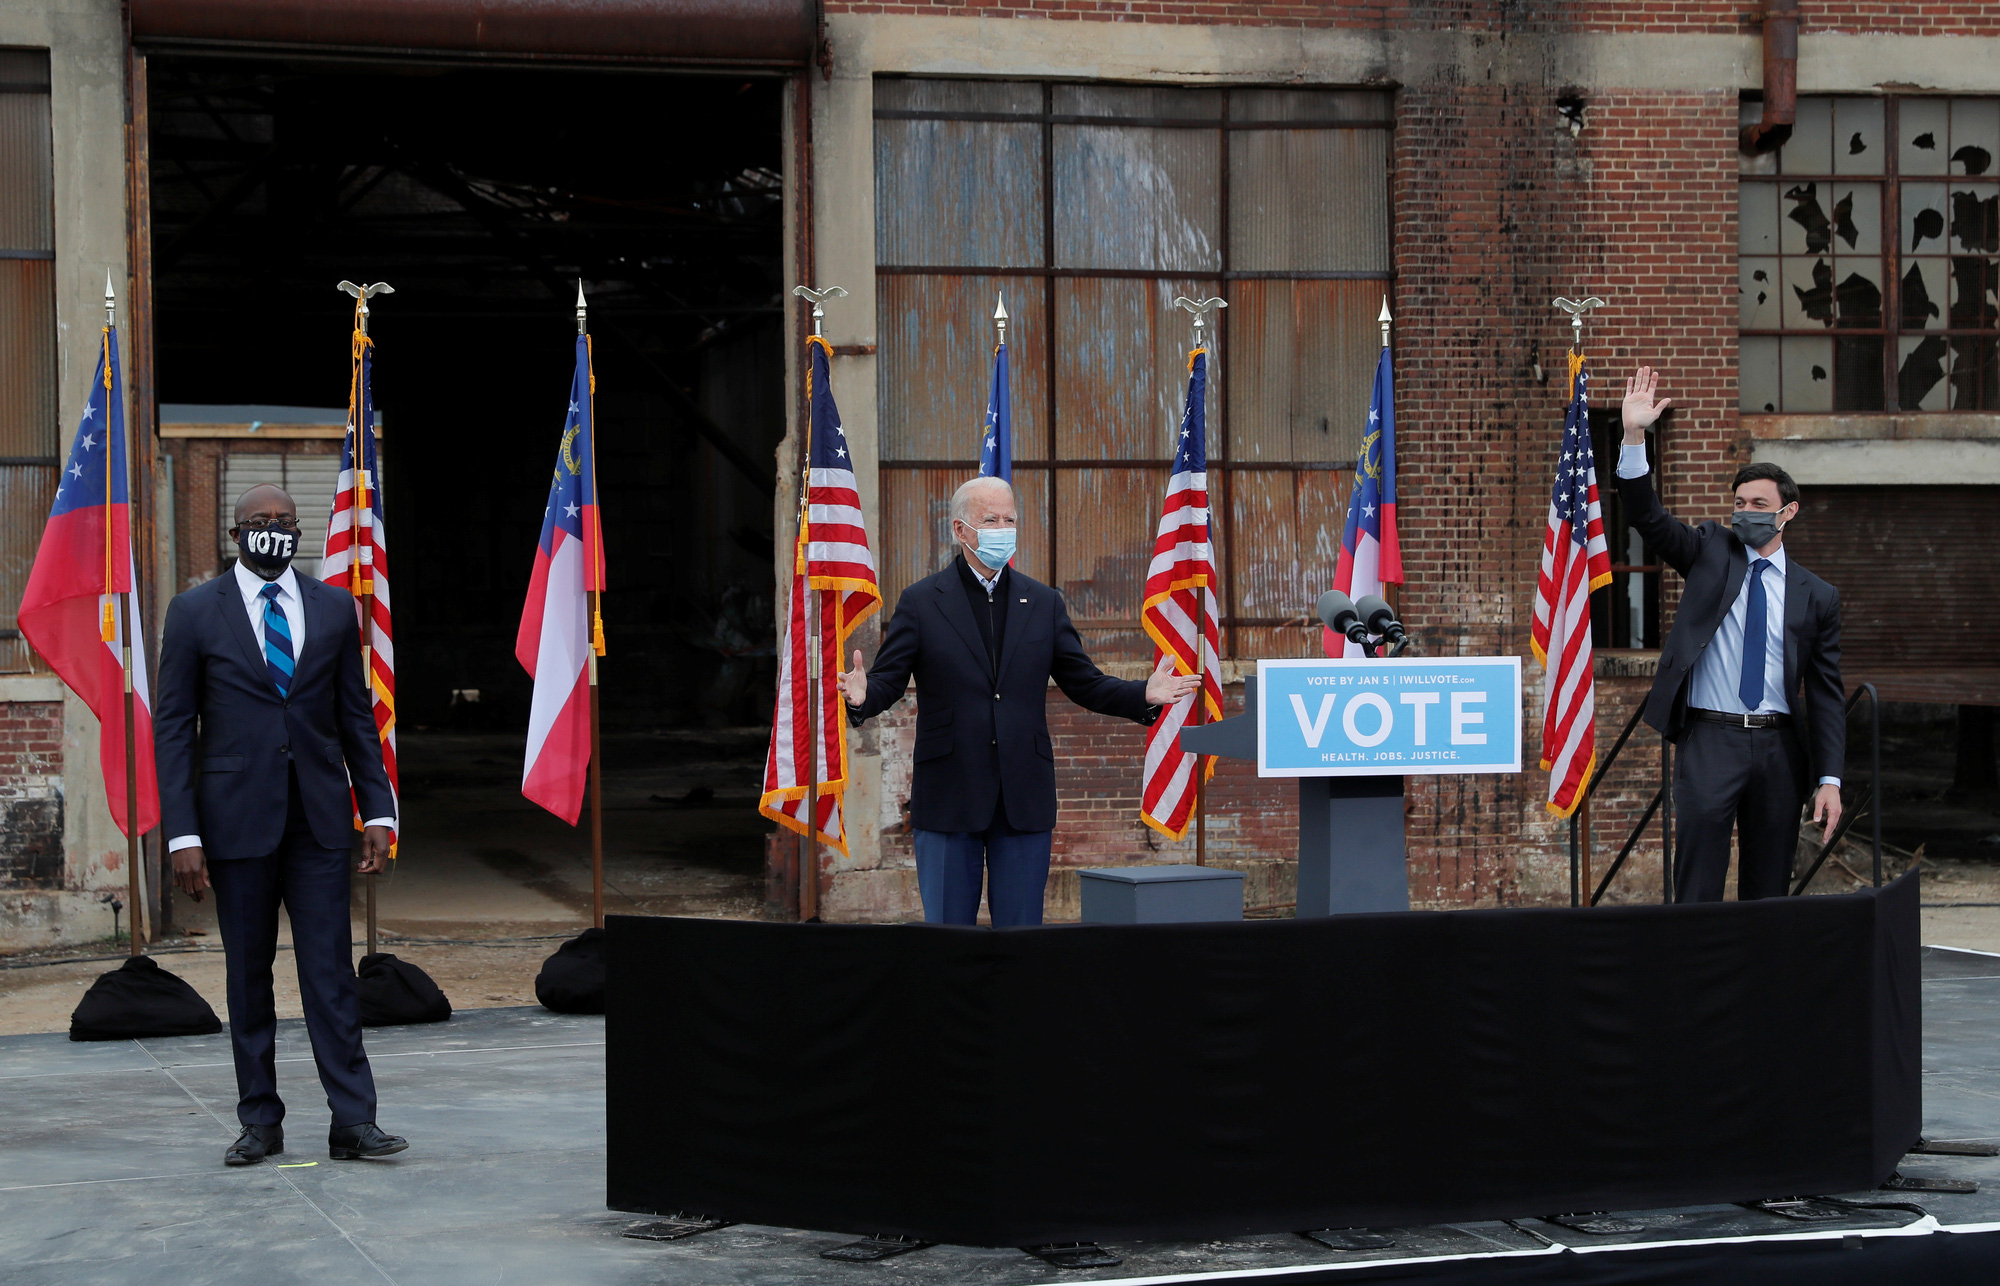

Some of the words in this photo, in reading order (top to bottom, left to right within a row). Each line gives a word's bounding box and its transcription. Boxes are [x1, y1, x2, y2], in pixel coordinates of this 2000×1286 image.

[247, 530, 293, 559] VOTE
[1306, 676, 1336, 686] VOTE
[1339, 676, 1354, 685] BY
[1357, 675, 1379, 685] JAN
[1382, 675, 1389, 685] 5
[1288, 691, 1488, 749] VOTE
[1321, 752, 1369, 762] HEALTH.
[1373, 751, 1406, 761] JOBS.
[1410, 750, 1461, 760] JUSTICE.
